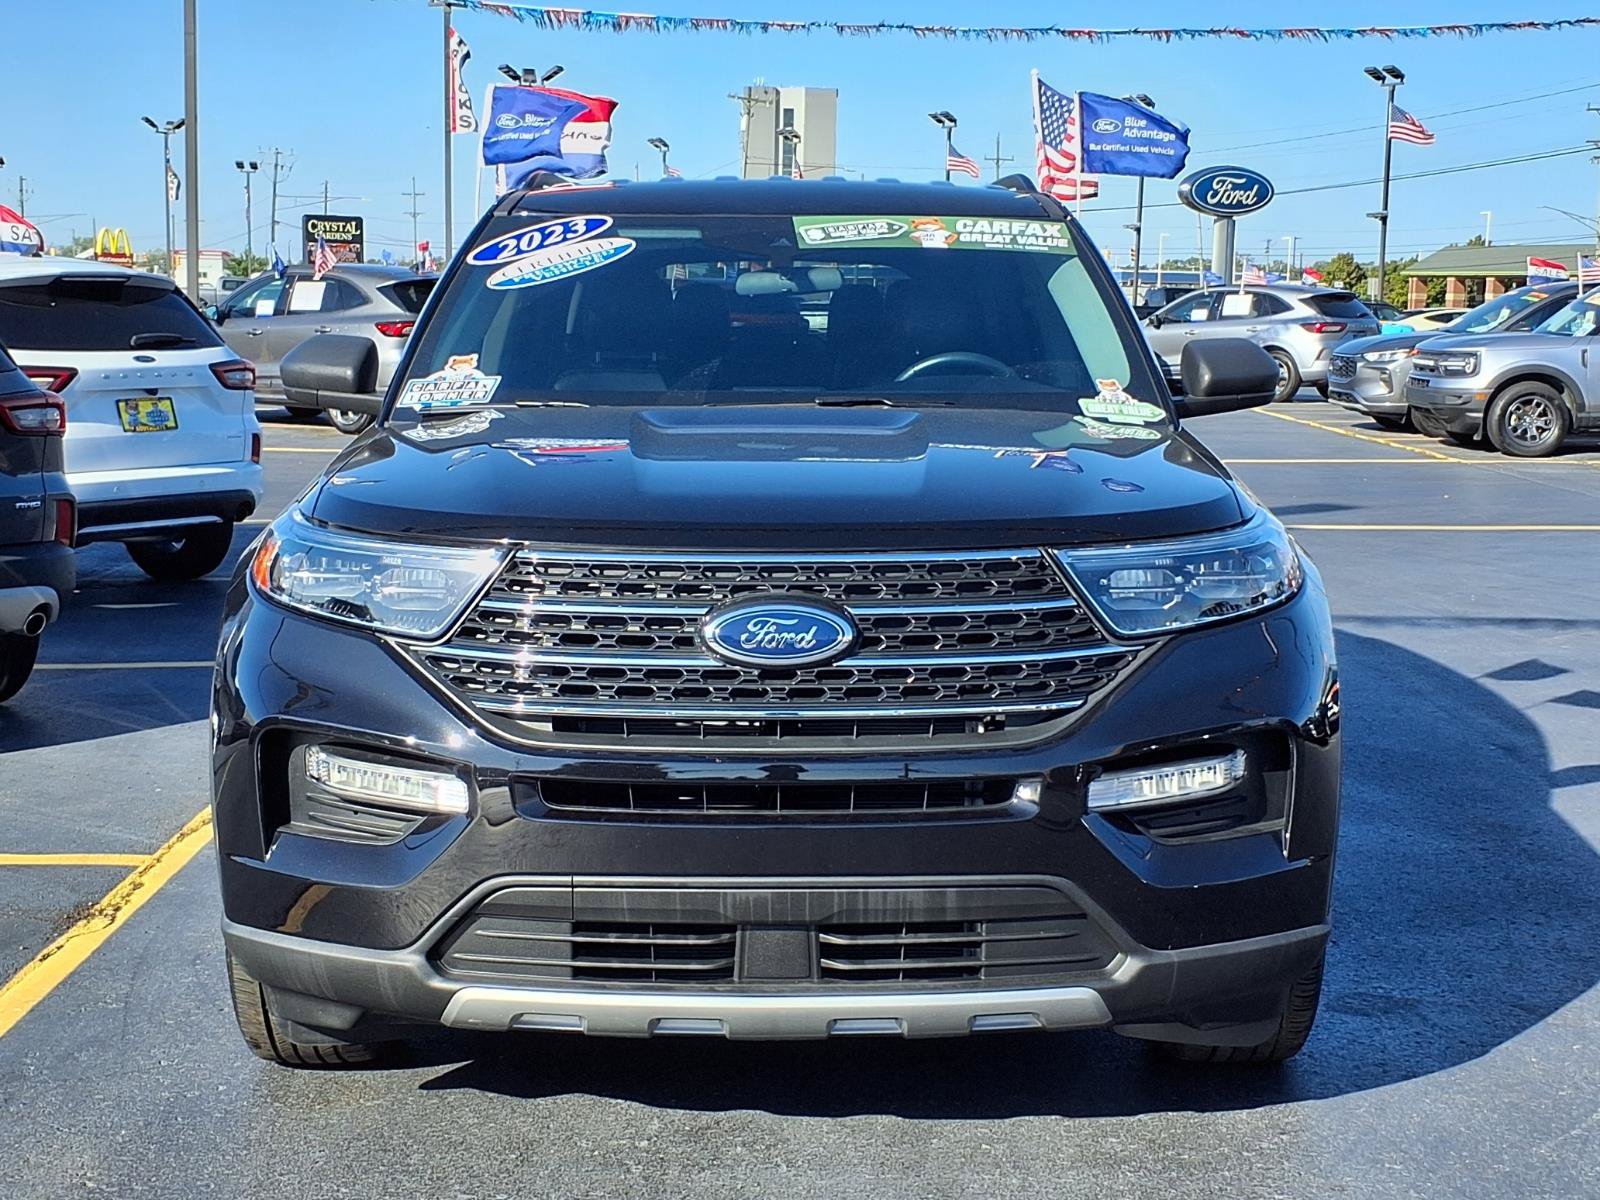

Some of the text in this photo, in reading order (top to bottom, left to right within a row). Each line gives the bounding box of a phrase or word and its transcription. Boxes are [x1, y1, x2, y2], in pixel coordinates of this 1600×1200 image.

[1124, 116, 1147, 128] Blue
[1123, 128, 1176, 142] Advantage
[1102, 143, 1130, 152] Certified
[1131, 144, 1149, 153] Used
[1150, 146, 1175, 156] Vehicle
[1206, 176, 1259, 205] Ford
[10, 225, 33, 243] SA
[307, 219, 361, 235] CRYSTAL
[955, 219, 1062, 238] CARFAX
[497, 219, 586, 260] 2023
[959, 232, 1013, 244] GREAT
[1015, 234, 1069, 248] VALUE
[1535, 268, 1562, 277] SALE
[740, 616, 818, 650] Ford
